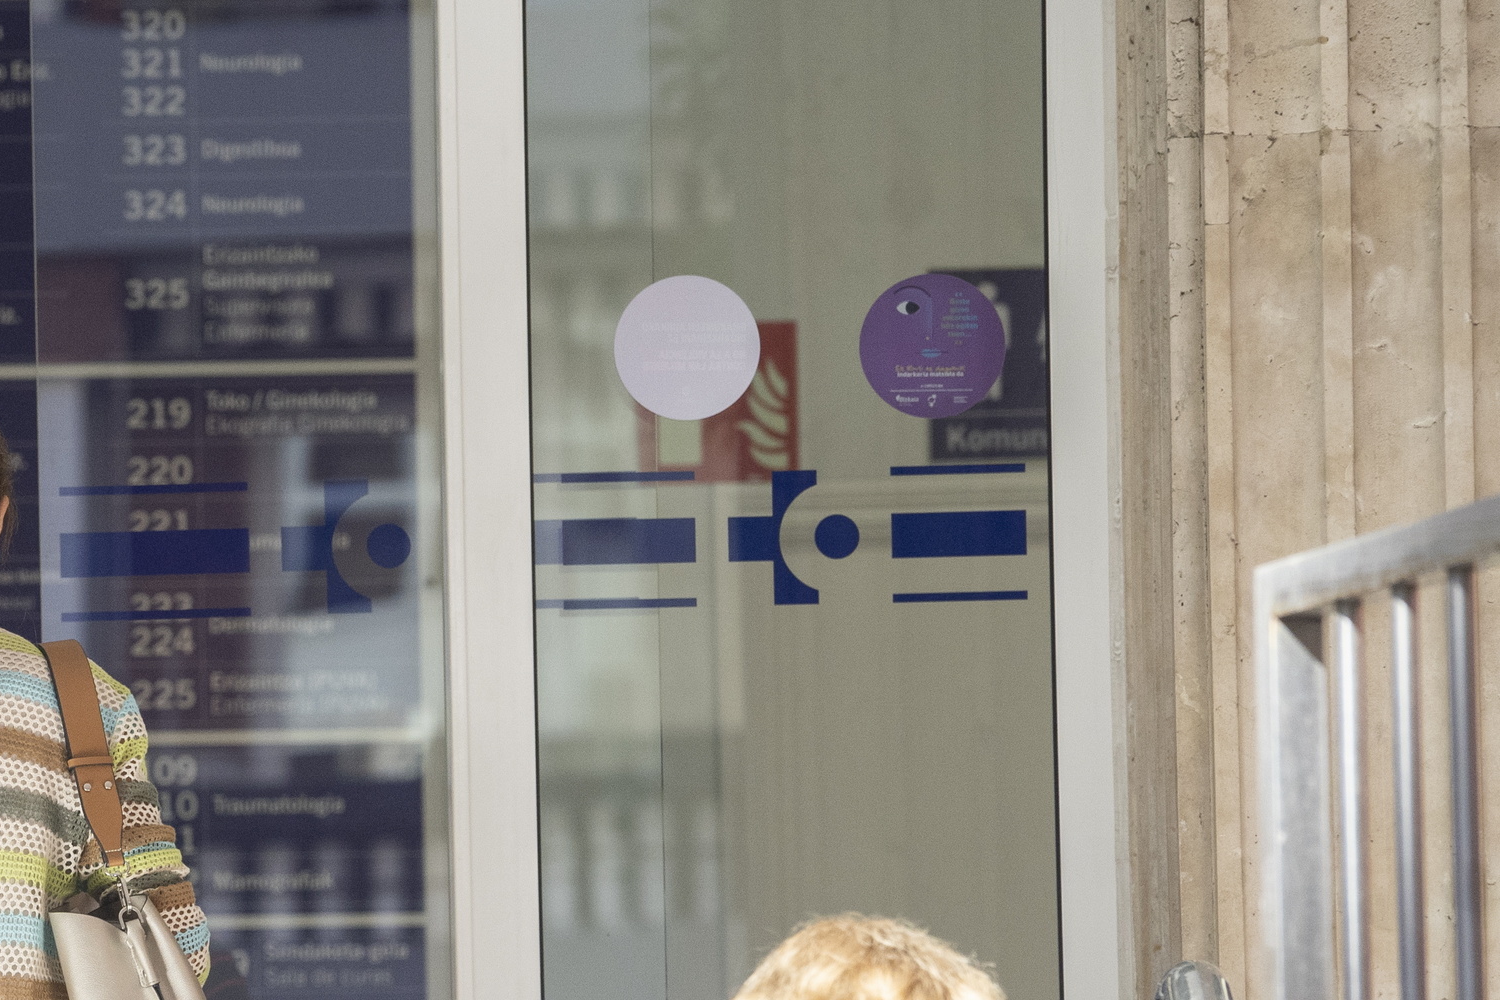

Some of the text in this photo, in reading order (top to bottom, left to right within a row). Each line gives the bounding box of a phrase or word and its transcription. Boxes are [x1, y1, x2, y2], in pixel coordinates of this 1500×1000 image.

[122, 10, 186, 41] 320
[122, 49, 182, 79] 321
[122, 86, 186, 117] 322
[123, 135, 187, 165] 323
[124, 190, 187, 221] 324
[127, 278, 190, 310] 325
[127, 398, 191, 430] 219
[128, 456, 193, 486] 220
[133, 626, 195, 657] 224
